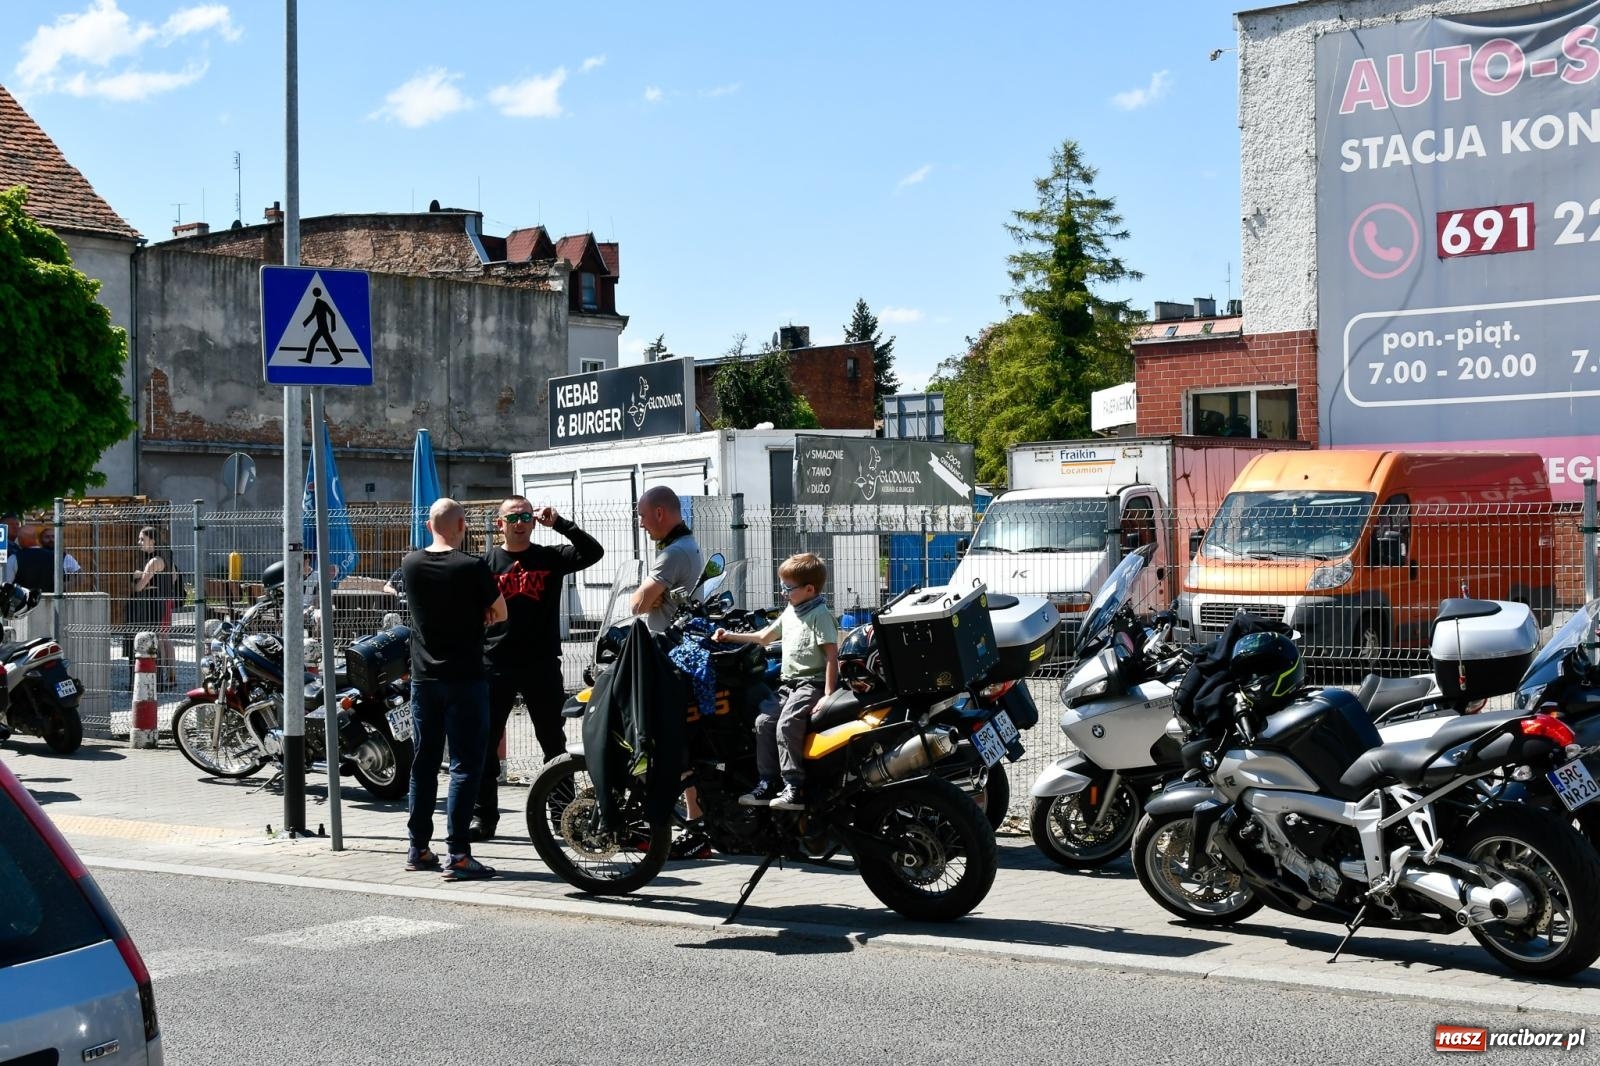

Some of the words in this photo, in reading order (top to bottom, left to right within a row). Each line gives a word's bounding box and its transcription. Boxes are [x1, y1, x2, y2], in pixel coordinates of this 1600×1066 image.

[1340, 124, 1487, 173] STACJA
[1441, 206, 1528, 255] 691
[1383, 320, 1521, 356] pon.-piąt.
[1368, 360, 1427, 385] 7.00
[1436, 369, 1448, 377] -
[1457, 353, 1537, 381] 20.00
[556, 380, 599, 409] KEBAB
[557, 415, 566, 438] &
[568, 408, 622, 437] BURGER
[1060, 449, 1096, 460] Fraikin
[1061, 465, 1103, 475] Locamion
[811, 482, 831, 494] DUŻO
[394, 706, 410, 720] TOS
[979, 727, 994, 746] SRC
[1559, 765, 1583, 785] SRC
[1563, 780, 1598, 806] NR20
